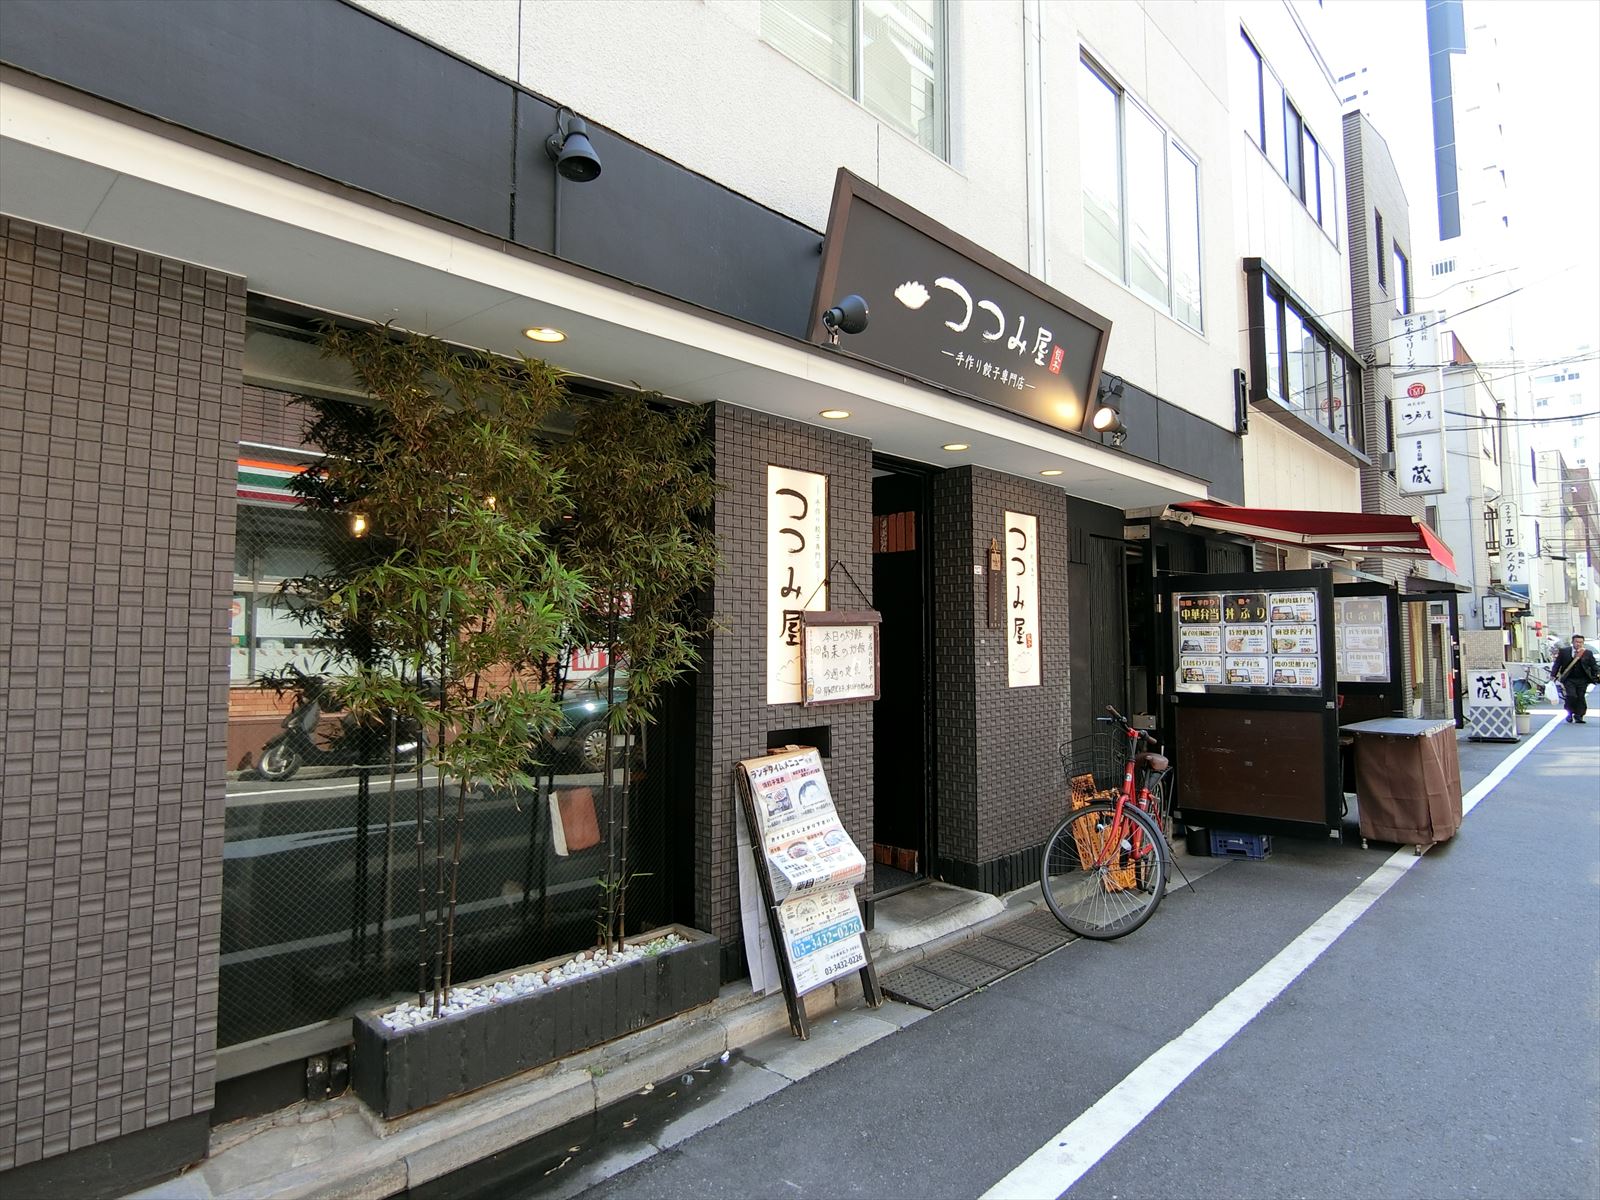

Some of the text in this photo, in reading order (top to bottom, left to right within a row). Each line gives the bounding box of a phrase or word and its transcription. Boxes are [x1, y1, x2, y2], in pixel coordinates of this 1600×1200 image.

[935, 277, 1052, 366] つつみ屋
[1412, 464, 1432, 485] 蔵
[775, 488, 809, 646] つつみ屋
[1008, 527, 1027, 645] つつみ屋
[1181, 608, 1220, 621] 中華弁当
[1225, 607, 1266, 620] 丼ぶり
[1476, 676, 1502, 701] 蔵
[750, 758, 804, 779] ランチタイムメニュー
[793, 922, 860, 958] 03-3432-0226
[825, 953, 863, 976] 03-3432-0226
